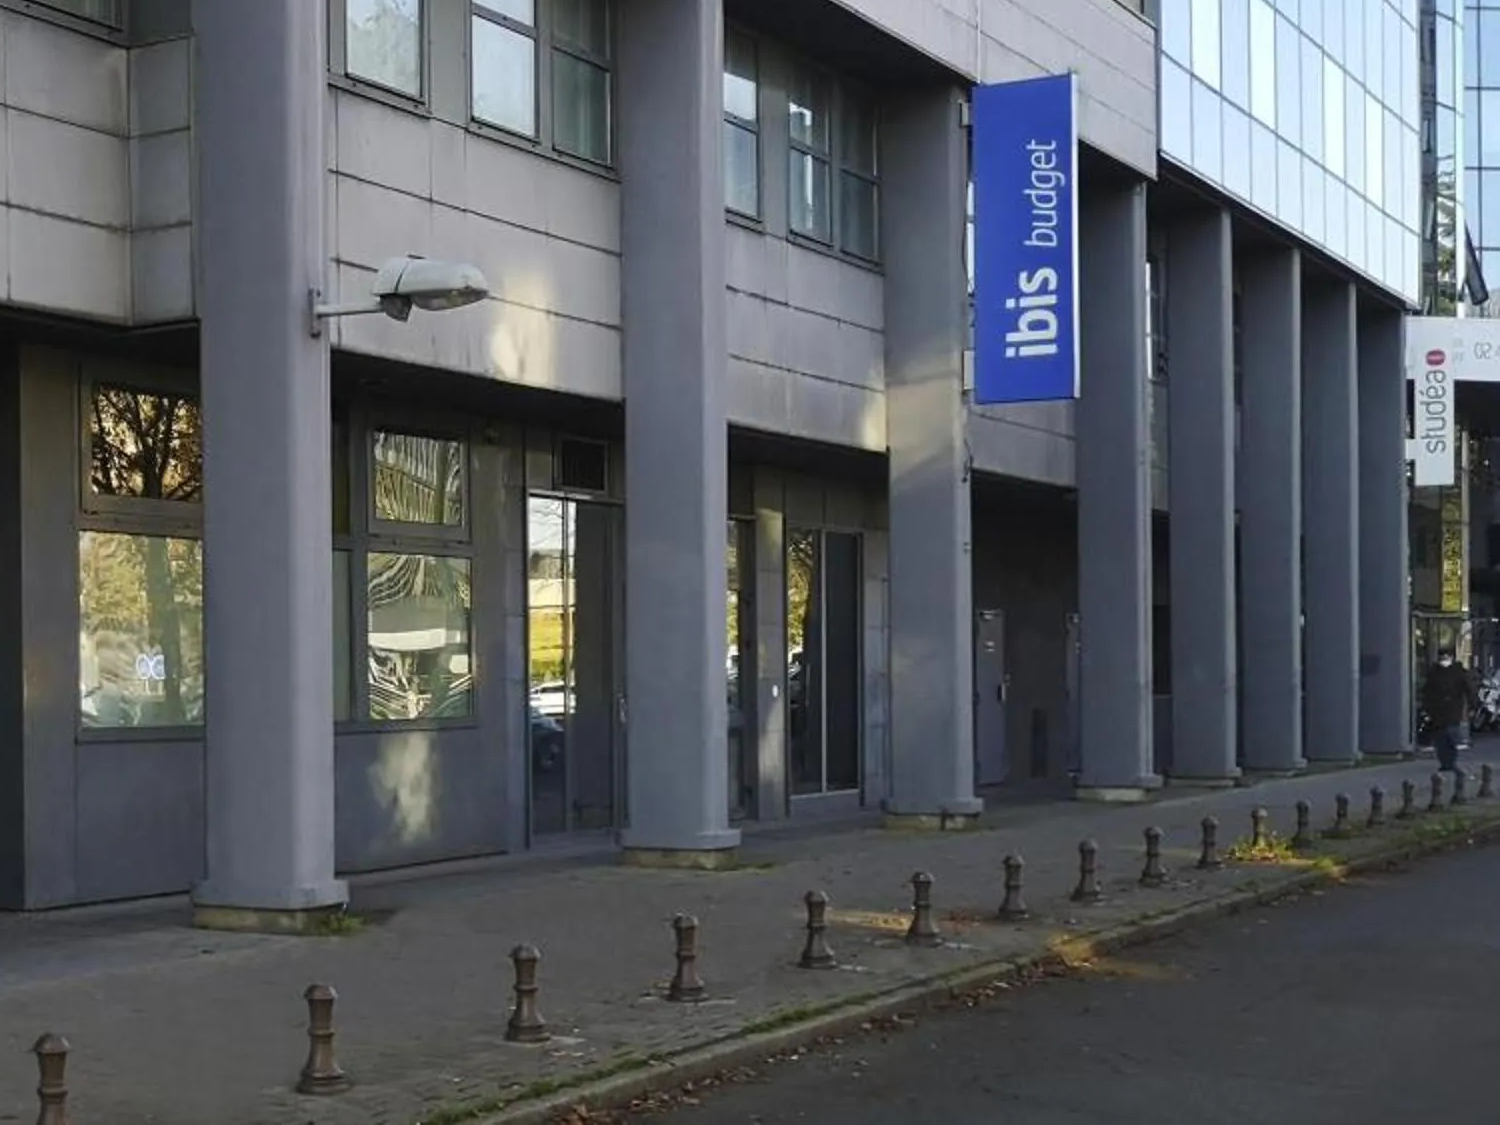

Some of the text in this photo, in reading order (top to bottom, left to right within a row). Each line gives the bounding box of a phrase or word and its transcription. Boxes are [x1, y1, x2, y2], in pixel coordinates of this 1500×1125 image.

[1005, 138, 1066, 358] ibis budget
[1419, 369, 1447, 455] studéa
